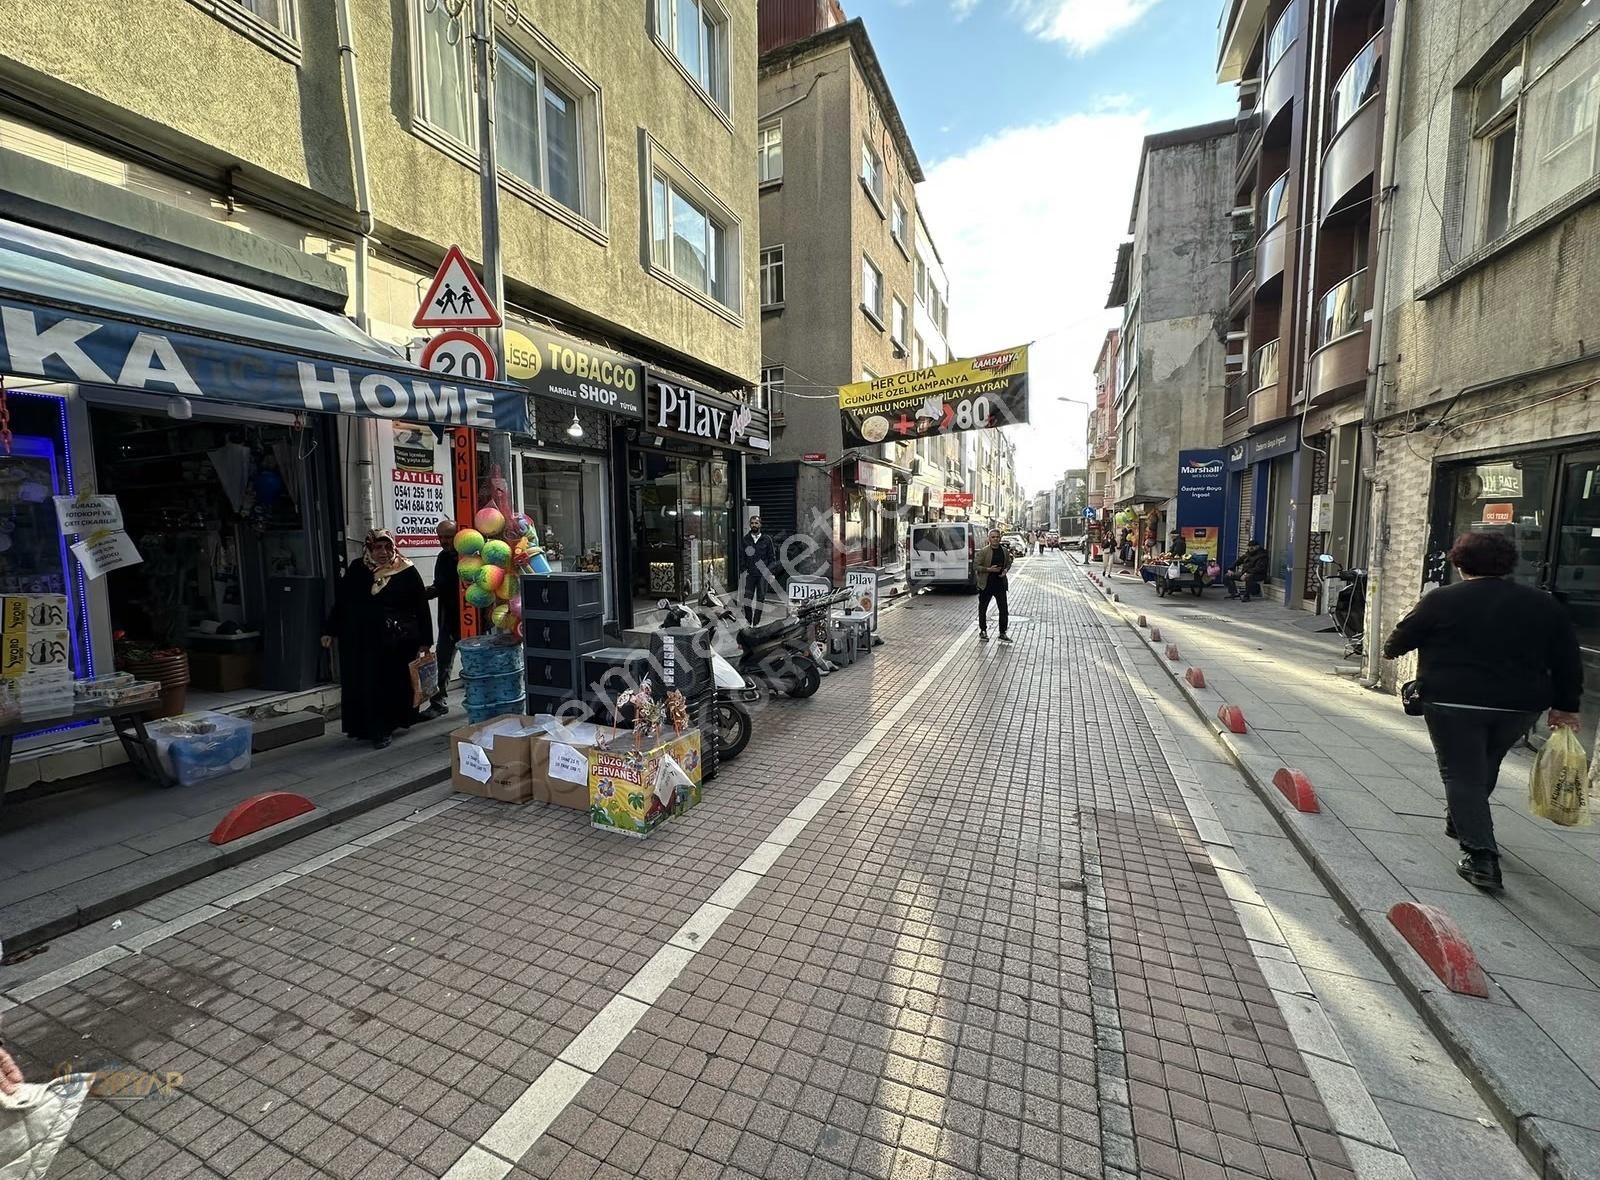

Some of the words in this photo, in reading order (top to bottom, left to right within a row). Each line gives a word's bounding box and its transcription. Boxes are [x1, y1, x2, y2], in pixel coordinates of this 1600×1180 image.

[2, 306, 204, 395] KA
[297, 361, 496, 428] HOME
[436, 352, 481, 378] 20
[506, 343, 537, 371] İSSA
[547, 343, 637, 392] TOBACCO
[972, 352, 1019, 370] KAMPANYA
[845, 391, 883, 405] GÜNÜNE
[886, 386, 909, 398] ÖZEL
[912, 374, 969, 392] KAMPANYA
[871, 378, 894, 391] HER
[898, 369, 936, 385] CUMA
[549, 385, 577, 398] NARGİLE
[579, 383, 618, 406] SHOP
[620, 401, 637, 412] TÜTÜN
[852, 403, 891, 416] TAVUKLU
[974, 379, 1008, 395] AYRAN
[657, 383, 726, 440] Pilav
[394, 471, 442, 484] SATILIK
[456, 434, 468, 499] OKUL
[1181, 465, 1220, 474] Marshall
[394, 485, 410, 497] 0541
[413, 486, 424, 499] 255
[427, 488, 433, 499] 11
[435, 488, 442, 500] 86
[394, 499, 411, 511] 0541
[412, 500, 424, 512] 684
[426, 501, 434, 512] 82
[434, 501, 443, 512] 90
[396, 526, 437, 534] GAYRİMENK
[401, 516, 439, 525] ORYAP
[408, 537, 440, 546] hepsiemla
[849, 574, 873, 585] Pilav
[793, 585, 824, 598] Pilav
[4, 638, 19, 669] SWORD
